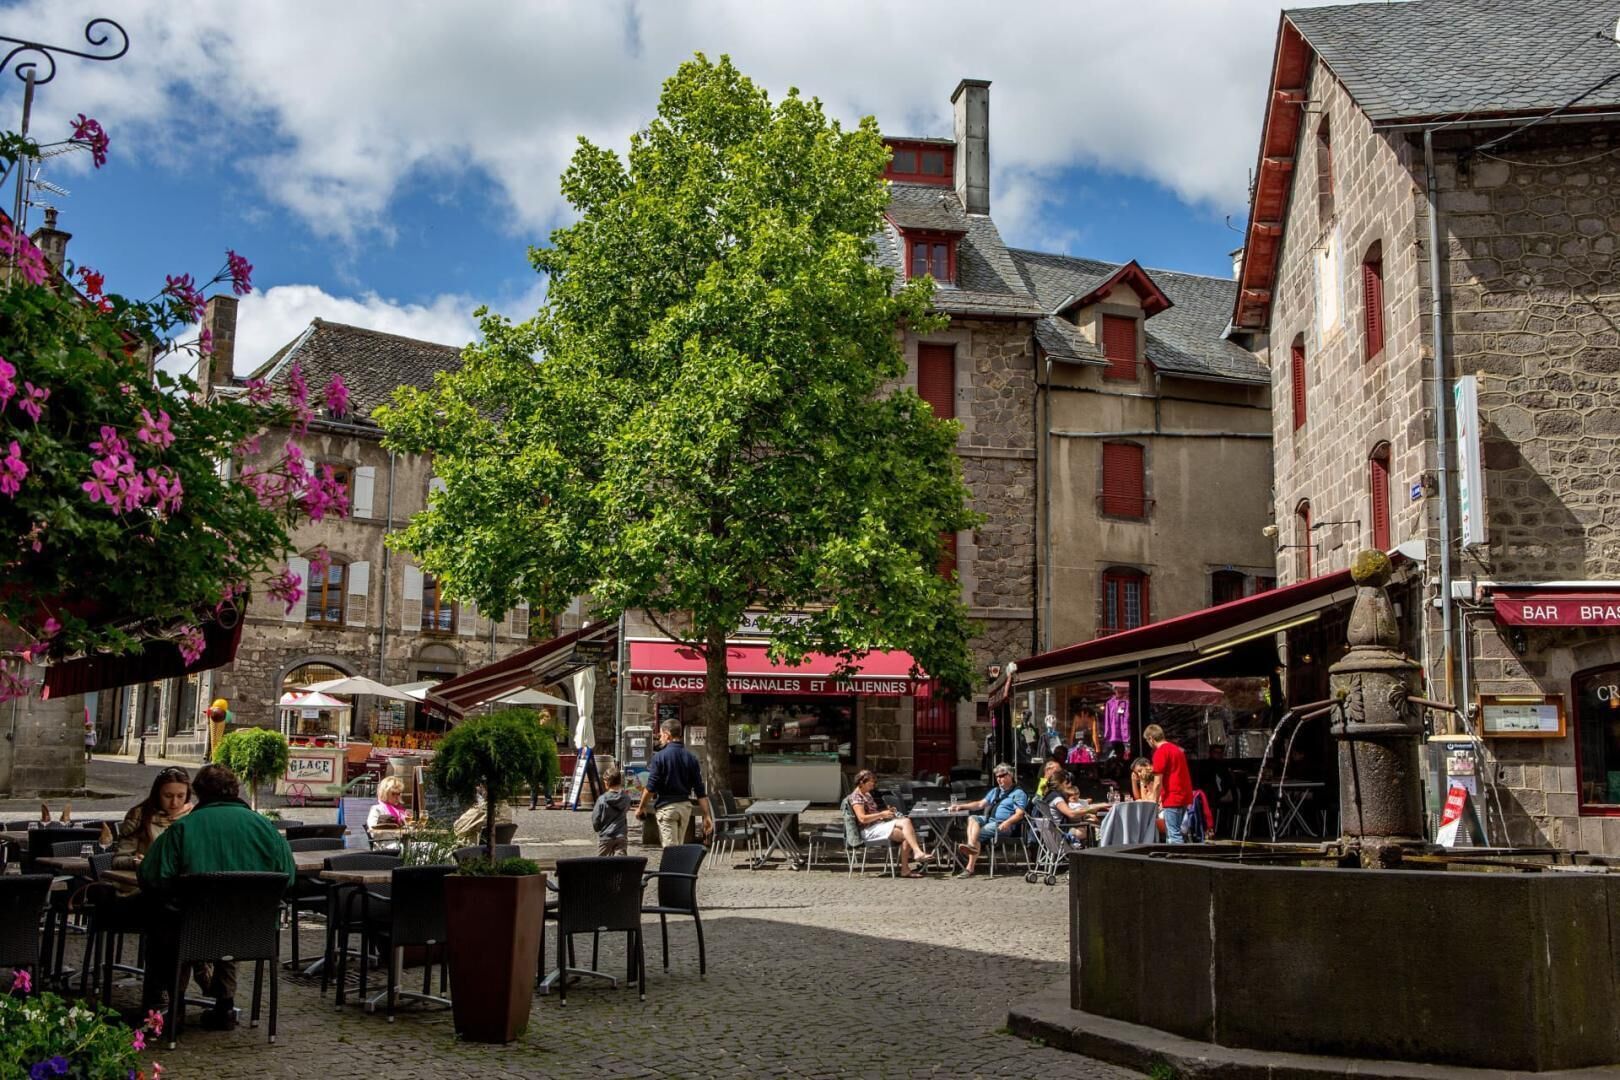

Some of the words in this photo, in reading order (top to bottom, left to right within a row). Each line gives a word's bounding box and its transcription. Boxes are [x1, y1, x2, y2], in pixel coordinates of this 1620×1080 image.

[1523, 606, 1558, 619] BAR
[652, 677, 704, 688] GLACES
[726, 678, 801, 690] RTISANALES
[810, 681, 826, 691] ET
[836, 681, 907, 692] ITALIENNES
[290, 760, 329, 772] GLACE
